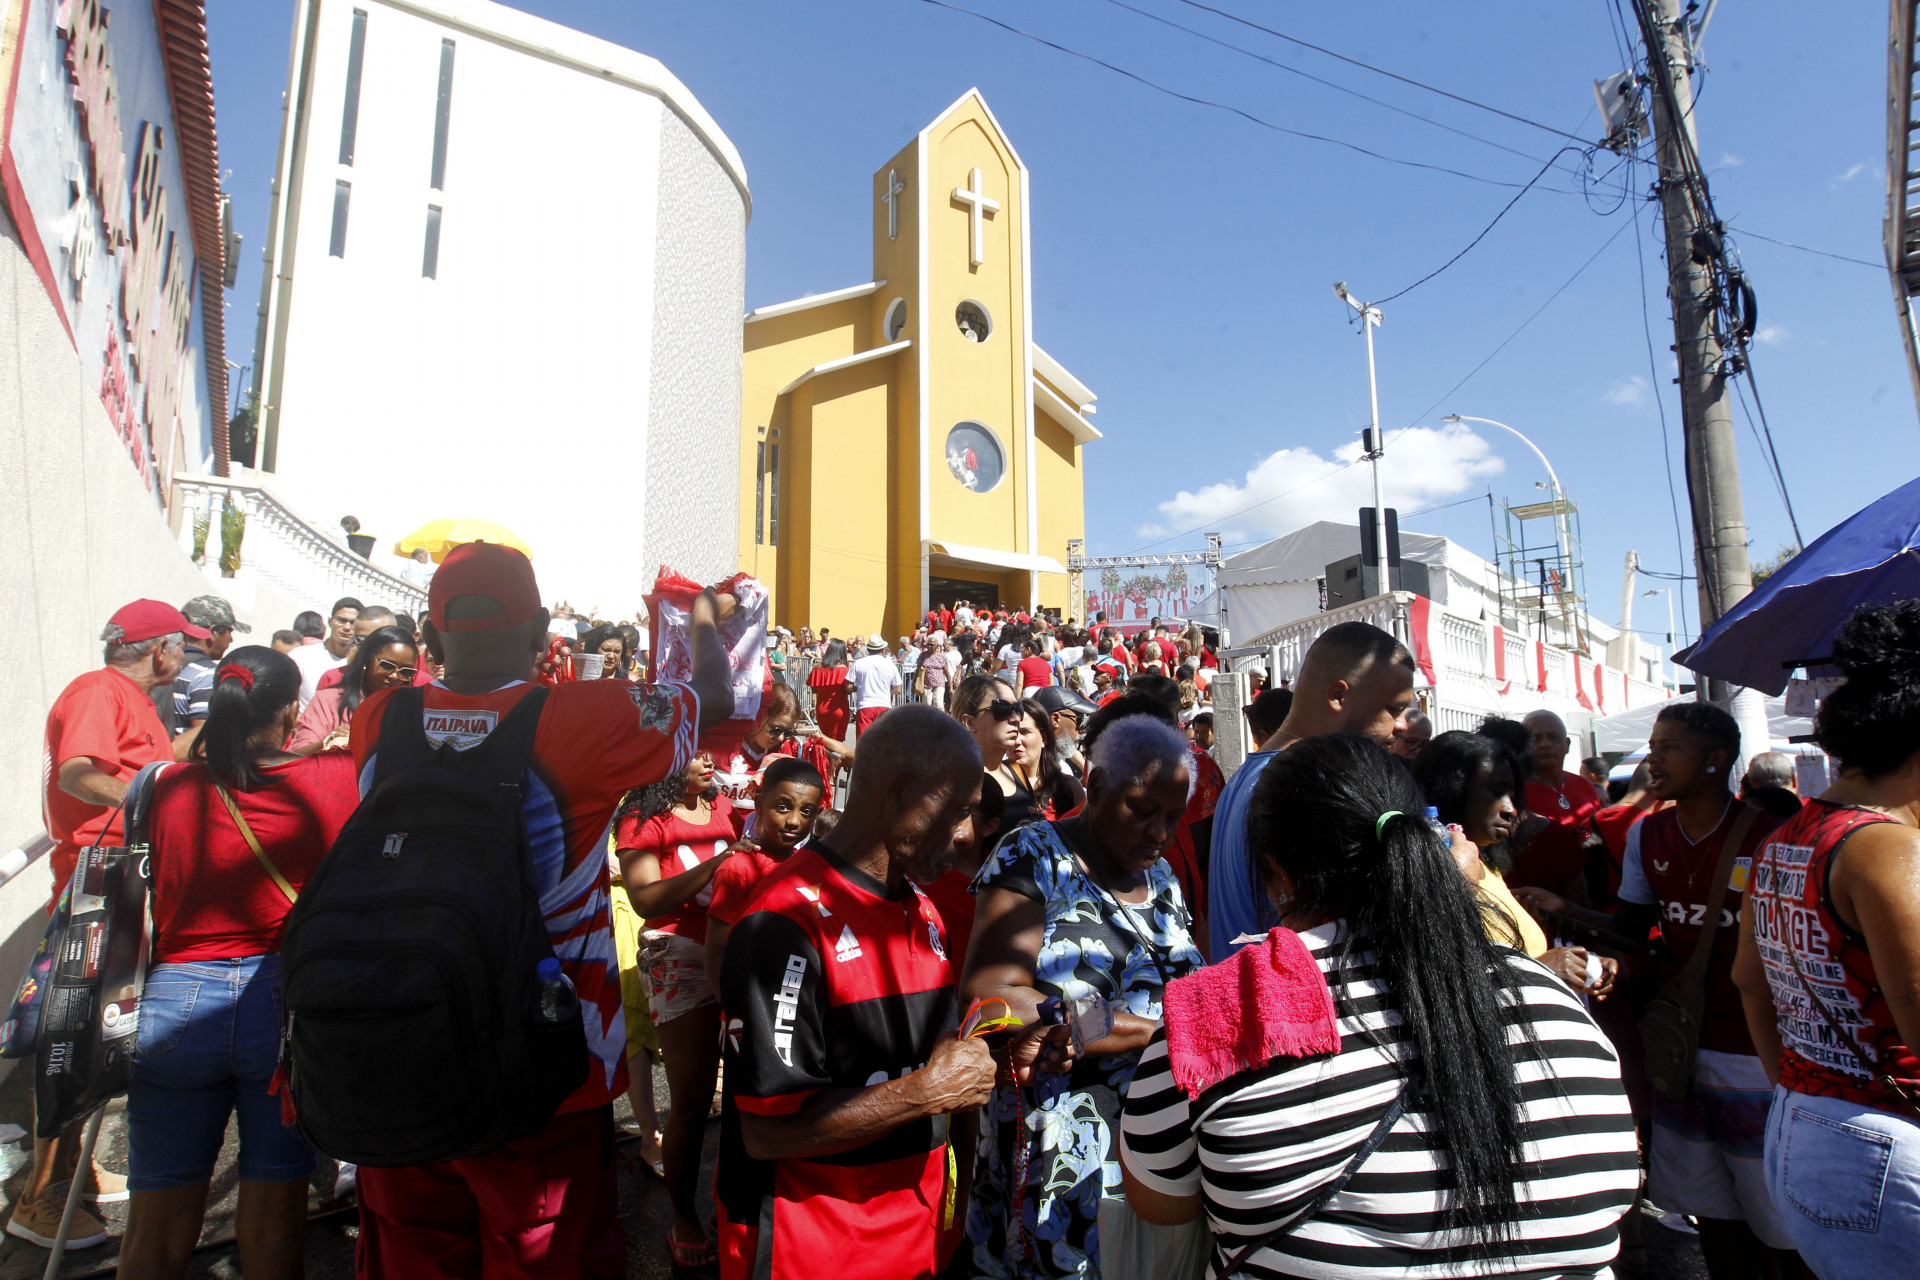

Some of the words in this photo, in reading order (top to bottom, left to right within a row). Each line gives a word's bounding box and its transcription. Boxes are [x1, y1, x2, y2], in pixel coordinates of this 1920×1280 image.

[424, 717, 489, 735] ITAIPAVA
[720, 783, 748, 801] SÃO
[89, 846, 99, 868] ARNE
[1658, 899, 1741, 928] AZO
[1825, 964, 1842, 980] ME
